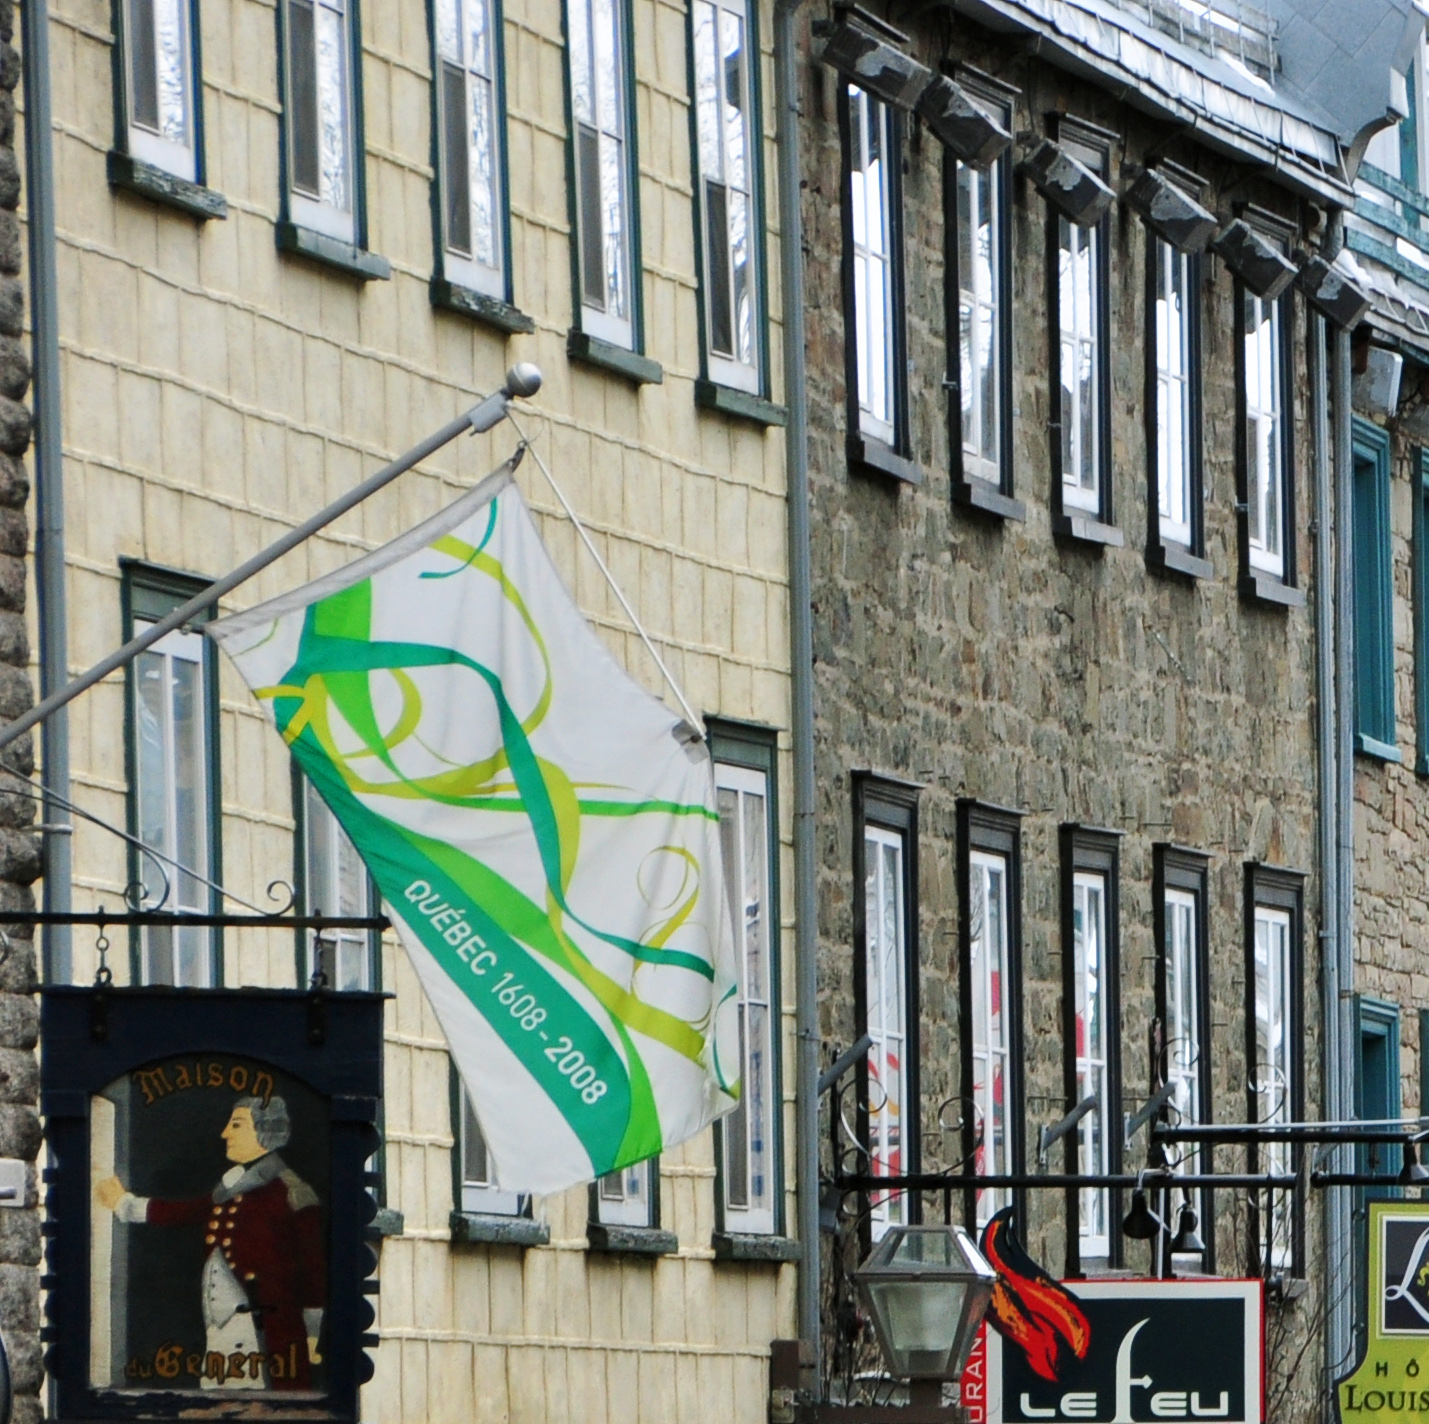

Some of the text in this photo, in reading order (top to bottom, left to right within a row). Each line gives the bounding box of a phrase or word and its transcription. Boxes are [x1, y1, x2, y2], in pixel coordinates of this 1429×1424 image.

[404, 879, 497, 976] QUÉBEC
[491, 972, 547, 1031] 1608
[544, 1036, 607, 1105] 2008
[132, 1062, 276, 1108] Maison
